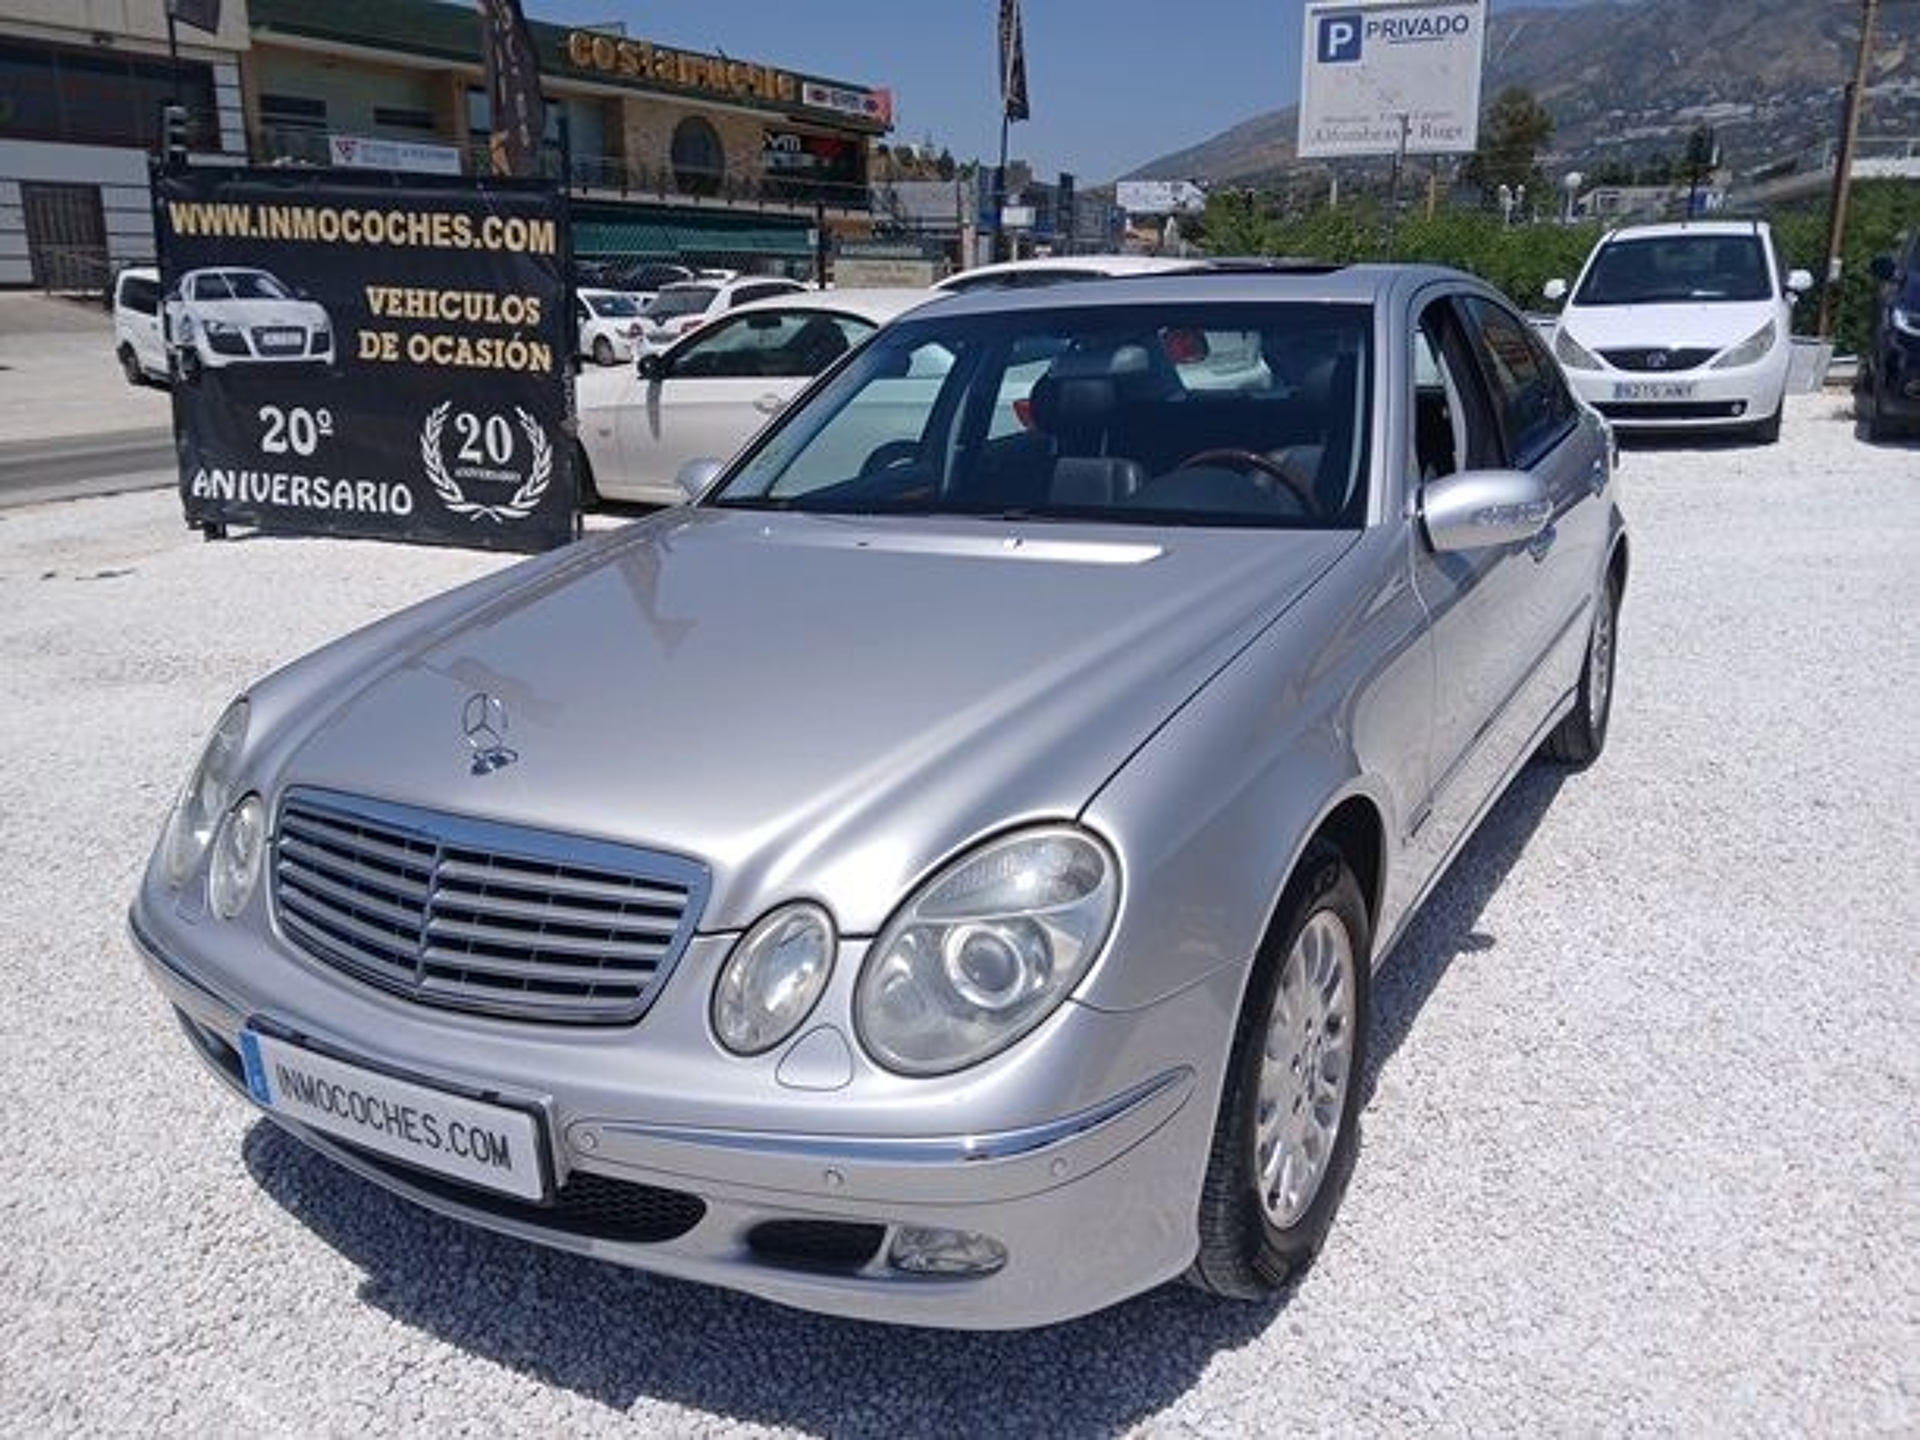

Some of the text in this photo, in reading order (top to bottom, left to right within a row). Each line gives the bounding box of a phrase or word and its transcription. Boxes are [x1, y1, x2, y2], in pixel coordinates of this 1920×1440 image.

[1328, 14, 1469, 58] P PRIVADO
[168, 202, 557, 256] WWW.INMOCOCHES.COM
[365, 286, 542, 325] VEHICULOS
[358, 331, 552, 373] DE OCASIÓN
[454, 412, 513, 465] 20
[192, 468, 414, 516] ANIVERSARIO
[275, 1062, 513, 1171] INMOCOCHES.COM
